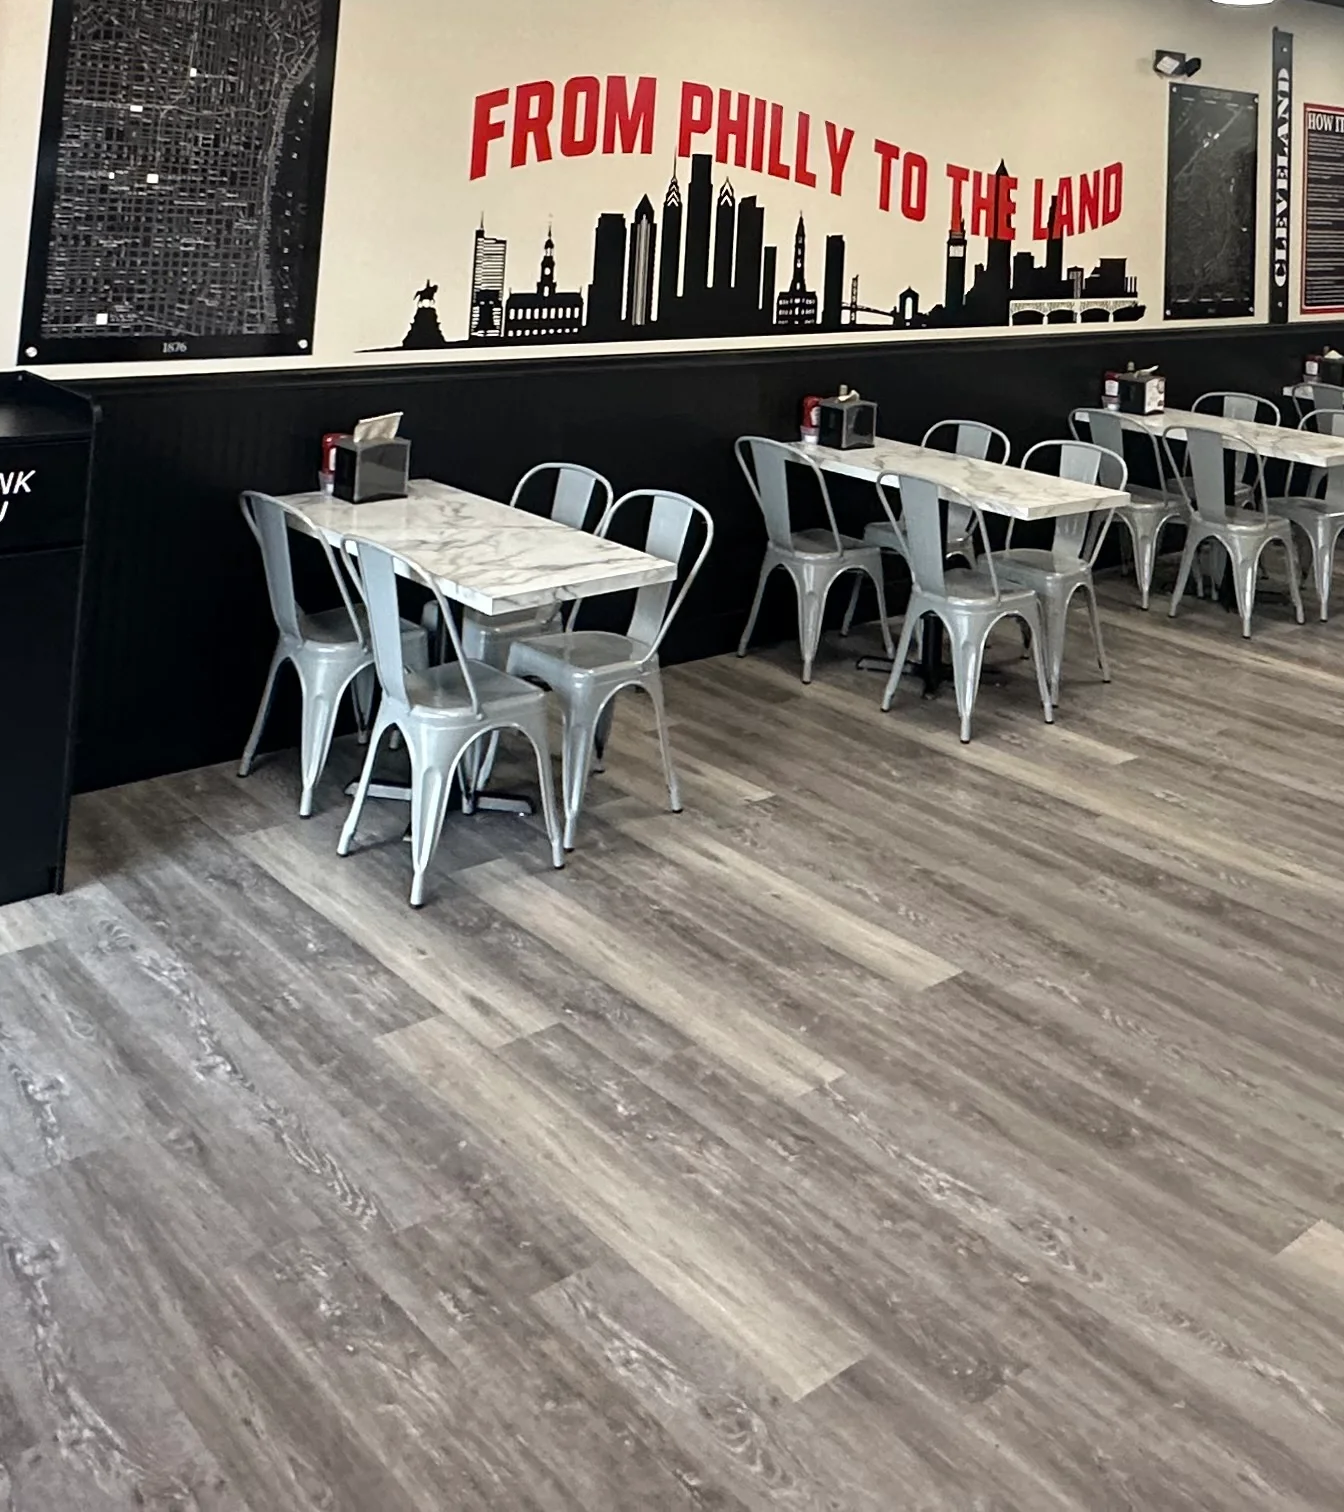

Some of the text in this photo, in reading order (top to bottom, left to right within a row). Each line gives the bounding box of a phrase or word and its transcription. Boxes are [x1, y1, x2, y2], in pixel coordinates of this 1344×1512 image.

[470, 75, 1123, 240] FROM PHILLY TO THE LAND
[1274, 67, 1290, 288] CLEVELAND
[1308, 112, 1334, 131] HOW
